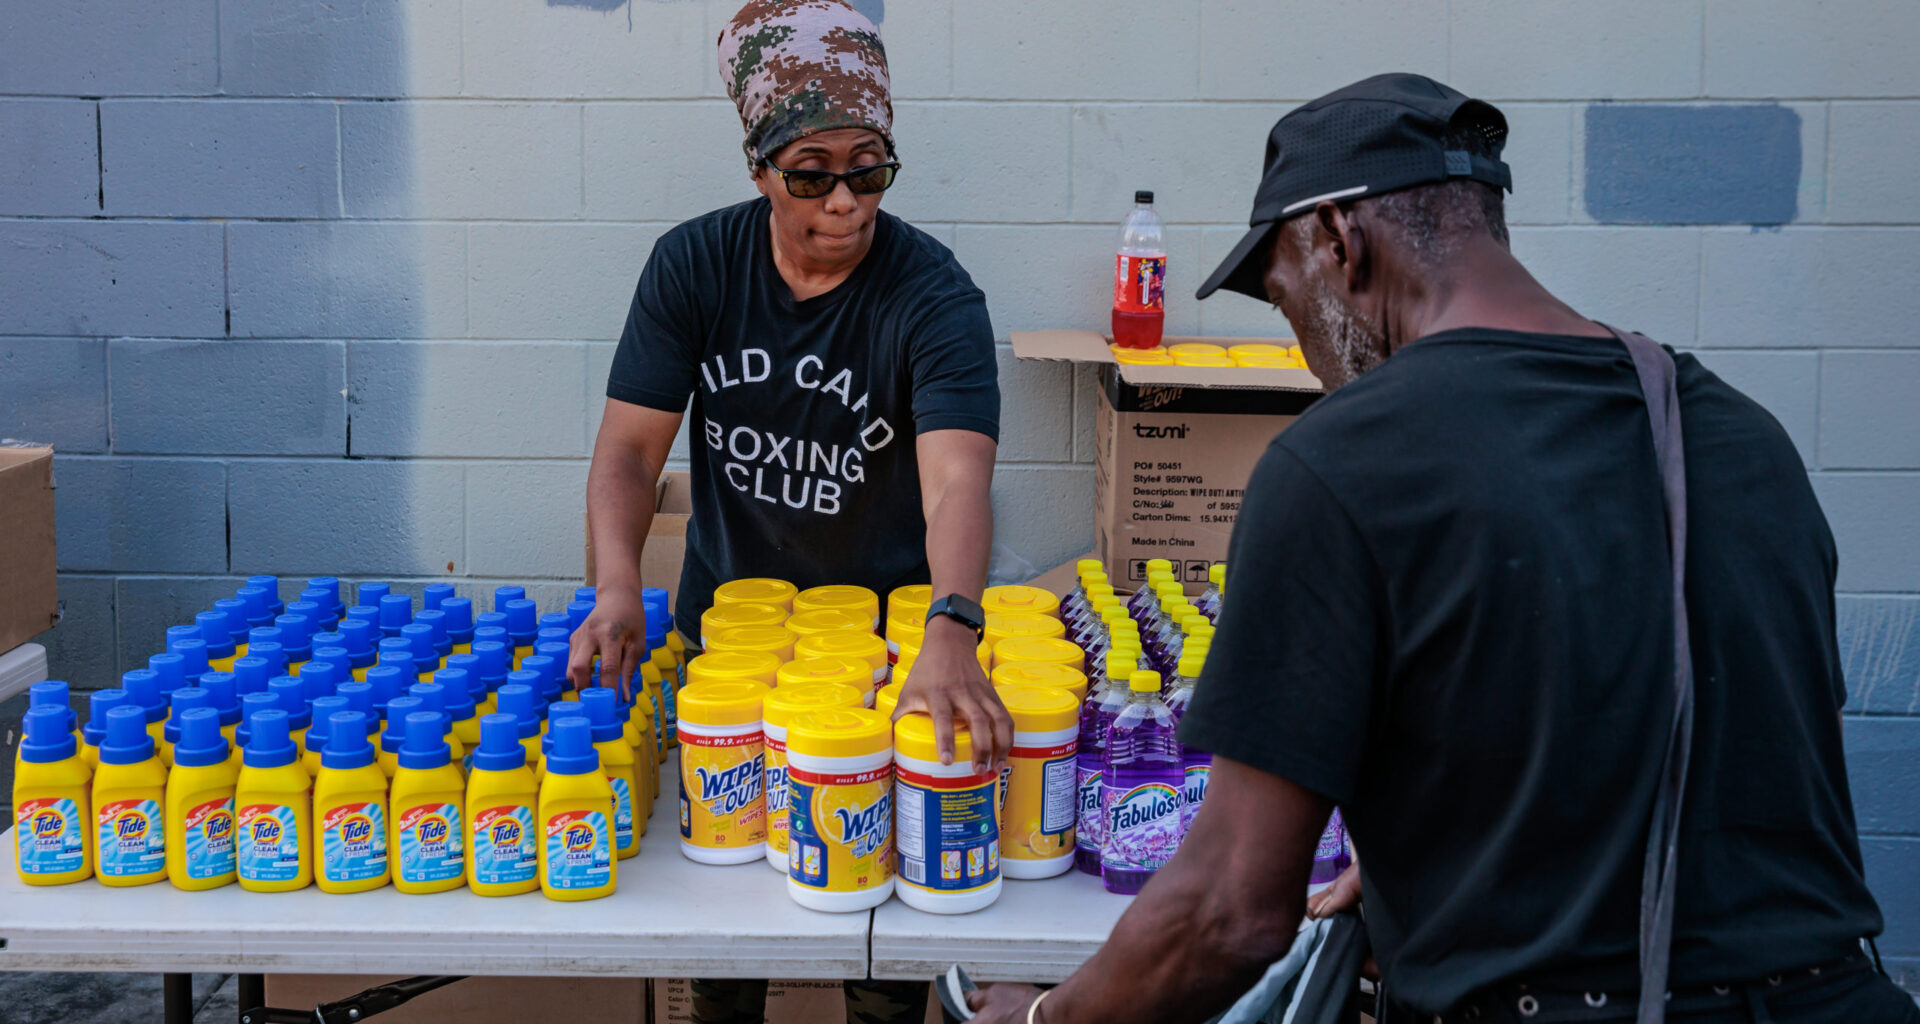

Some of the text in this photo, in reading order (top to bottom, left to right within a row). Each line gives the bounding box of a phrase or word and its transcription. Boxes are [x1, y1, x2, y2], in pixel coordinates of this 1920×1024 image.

[700, 348, 771, 393] ILD
[1133, 423, 1186, 439] tzumi
[705, 416, 865, 483] BOXING
[1134, 462, 1182, 470] PO# 50451
[725, 462, 842, 515] CLUB
[1133, 474, 1203, 484] Style# 9597WG
[1133, 487, 1188, 497] Description:
[1190, 488, 1207, 497] WIPE
[1208, 488, 1224, 497] OUT!
[1207, 501, 1216, 510] of
[1132, 513, 1163, 521] Carton
[1165, 514, 1191, 522] Dims:
[1132, 537, 1195, 547] Made in China
[695, 752, 764, 800] WIPE
[766, 767, 788, 792] IPE
[725, 776, 763, 814] OUT!
[739, 810, 763, 826] WIPES
[1110, 792, 1182, 833] Fabuloso
[34, 815, 63, 835] Tide
[118, 817, 146, 837] Tide
[207, 816, 232, 839] Tide
[253, 822, 280, 841] Tide
[343, 821, 370, 842] Tide
[419, 821, 447, 843] Tide
[493, 824, 520, 844] Tide
[207, 840, 231, 848] CLEAN
[566, 829, 593, 849] Tide
